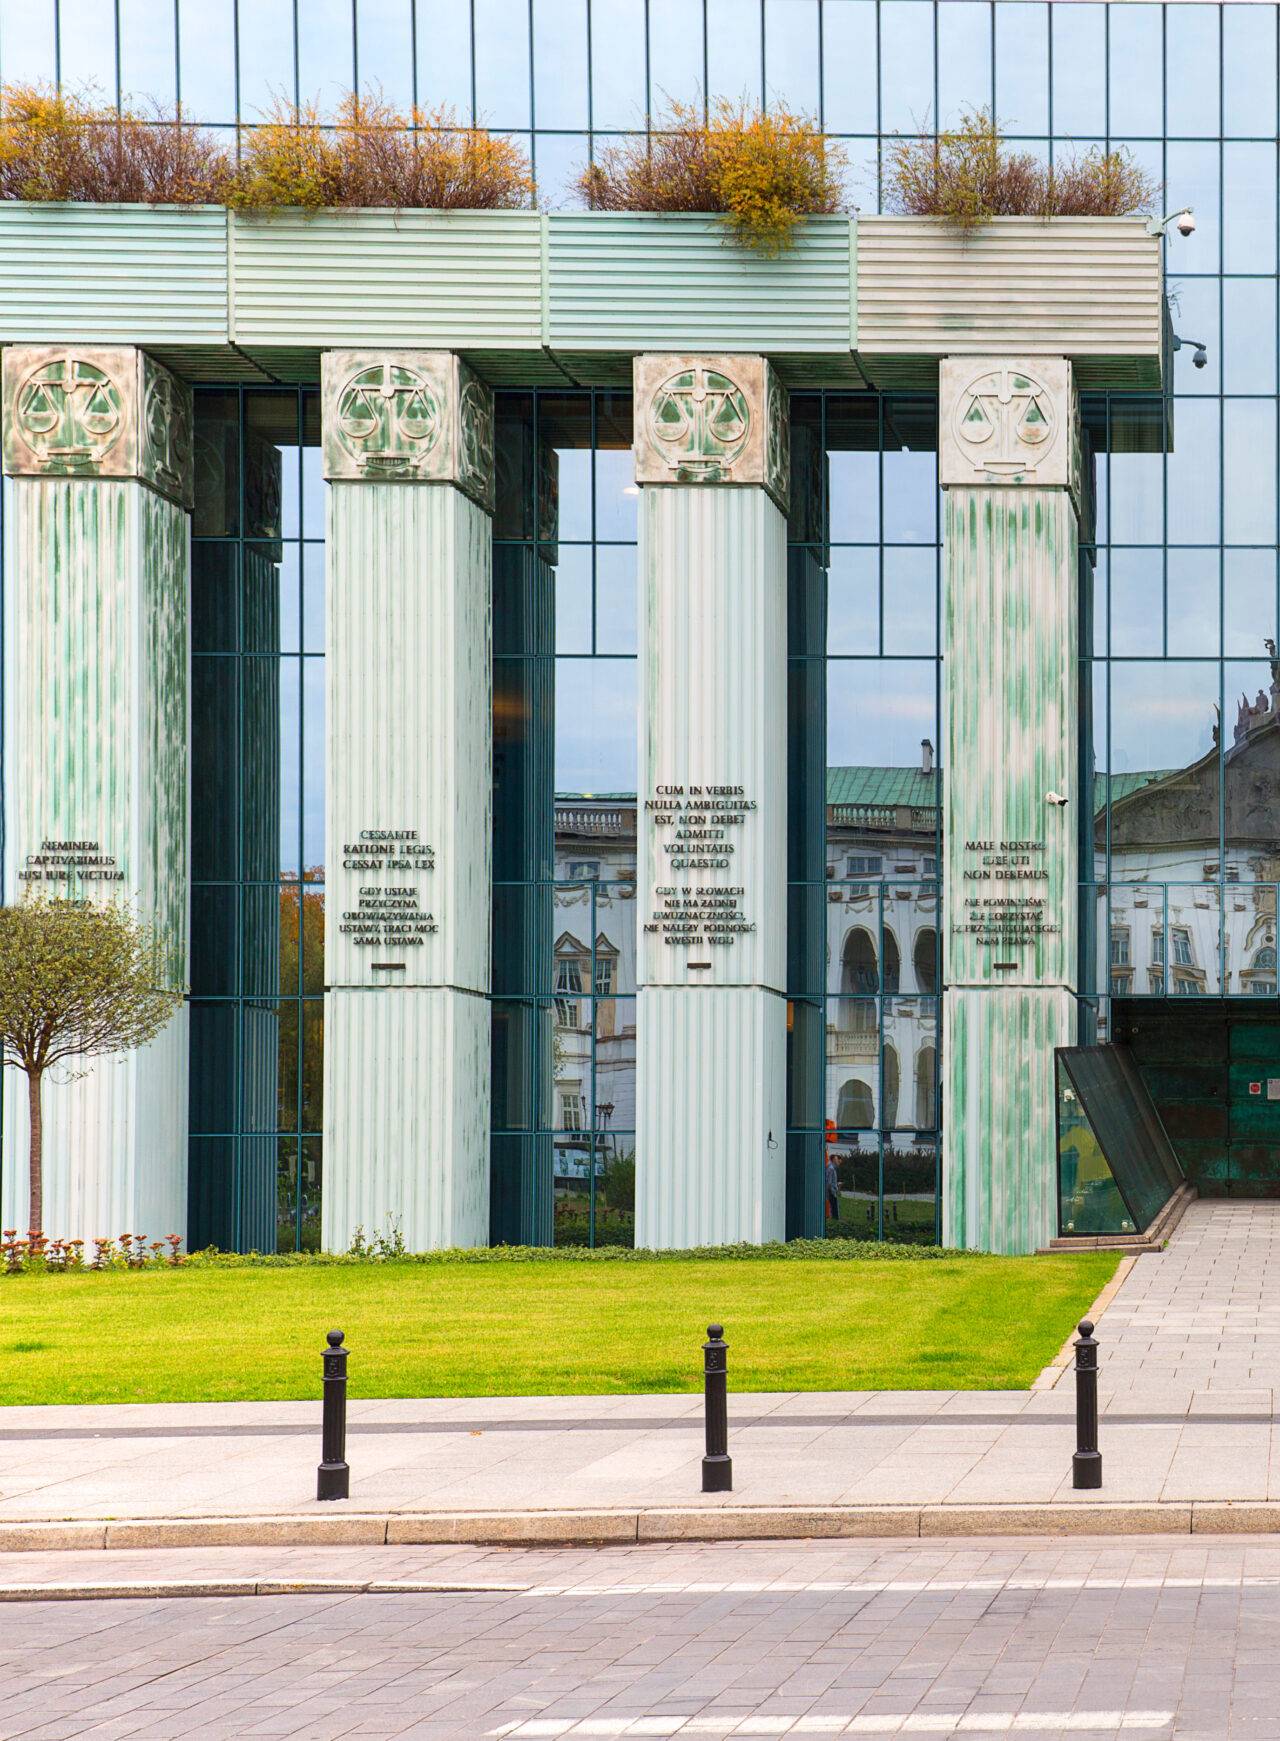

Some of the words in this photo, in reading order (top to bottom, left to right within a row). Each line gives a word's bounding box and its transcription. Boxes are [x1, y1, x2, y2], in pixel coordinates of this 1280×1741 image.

[656, 786, 683, 795] CUM
[689, 786, 702, 795] IN
[706, 786, 744, 795] VERBIS
[644, 800, 682, 809] NULLA
[685, 800, 757, 809] AMBIGUITAS
[654, 815, 674, 825] EST,
[679, 815, 706, 824] NON
[711, 815, 746, 824] DEBET
[360, 830, 418, 840] CESSANTE
[675, 830, 724, 839] ADMITTI
[41, 841, 99, 850] NEMINEM
[664, 844, 734, 853] VOLUNTATIS
[965, 842, 995, 850] MALE
[343, 845, 395, 854] RATIONE
[400, 845, 435, 856] LEGIS,
[343, 860, 384, 869] CESSAT
[388, 860, 412, 869] IPSA
[415, 860, 435, 869] LEX
[671, 858, 729, 870] QUAESTIO
[1011, 856, 1030, 865] UTI
[18, 871, 42, 880] NISI
[77, 871, 125, 880] VICTUM
[964, 871, 991, 880] NON
[995, 871, 1049, 880] DEBEMUS
[359, 887, 381, 896] GDY
[384, 887, 418, 897] USTAJE
[656, 887, 677, 895] GDY
[682, 887, 692, 895] W
[359, 900, 418, 908] PRZYCZYNA
[664, 899, 681, 907] NIE
[964, 898, 980, 906] NIE
[383, 924, 411, 933] TRACI
[414, 924, 439, 933] MOC
[644, 924, 659, 932] NIE
[353, 937, 381, 945] SAMA
[384, 937, 424, 945] USTAWA
[664, 936, 703, 944] KWESTII
